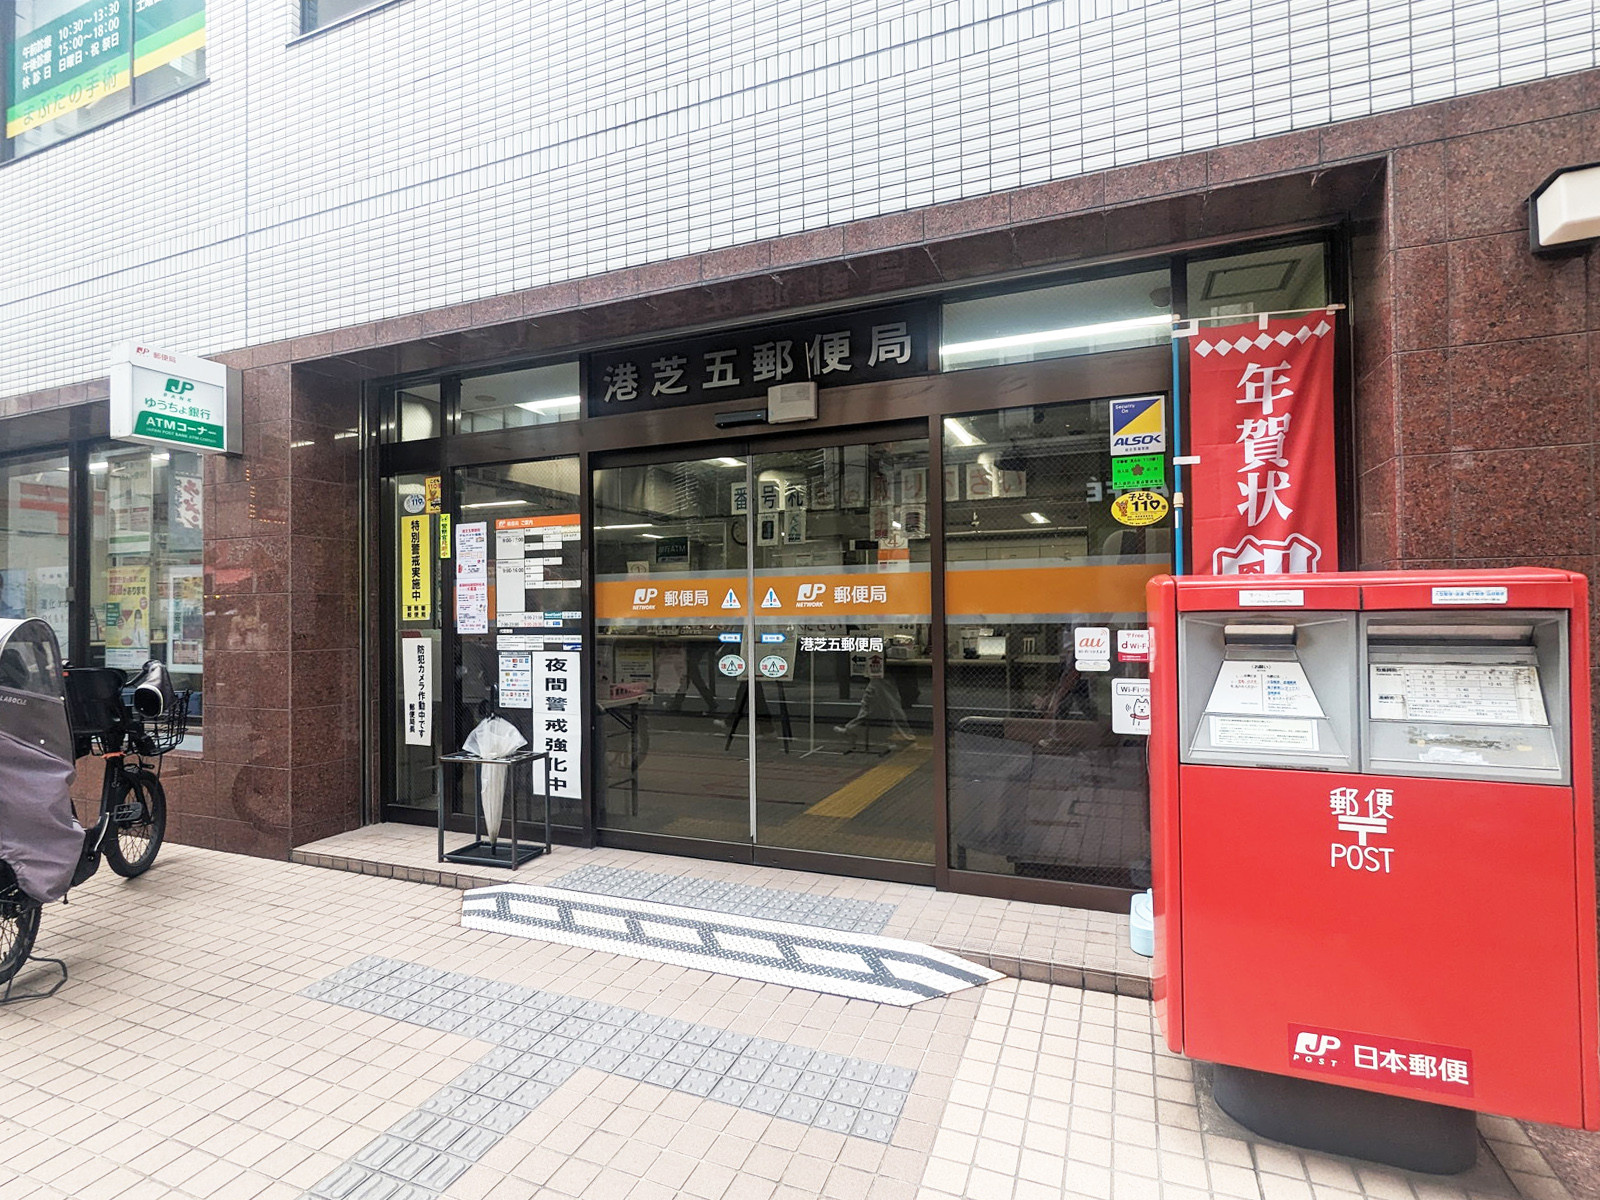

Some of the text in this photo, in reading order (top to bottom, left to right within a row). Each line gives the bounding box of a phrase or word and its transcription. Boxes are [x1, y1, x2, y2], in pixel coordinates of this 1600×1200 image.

[603, 321, 912, 403] 港芝五郵便局
[144, 397, 211, 420] ゆうちょ銀行
[145, 416, 217, 435] ATMコーナー
[1113, 434, 1162, 447] ALSOK
[1236, 359, 1294, 527] 年賀状
[1128, 493, 1153, 501] 子ども
[411, 519, 421, 601] 特別警戒実施中
[664, 590, 709, 607] 郵便局
[834, 585, 887, 604] 郵便局
[800, 637, 884, 653] 港芝五郵便局
[1079, 637, 1106, 648] au
[1121, 641, 1128, 649] d
[416, 644, 427, 738] 防犯カメラ作動中です
[545, 657, 568, 792] 夜間警戒強化中
[1329, 786, 1395, 820] 郵便
[1330, 843, 1395, 873] POST
[1292, 1054, 1338, 1068] POST
[1353, 1044, 1470, 1086] 日本郵便
